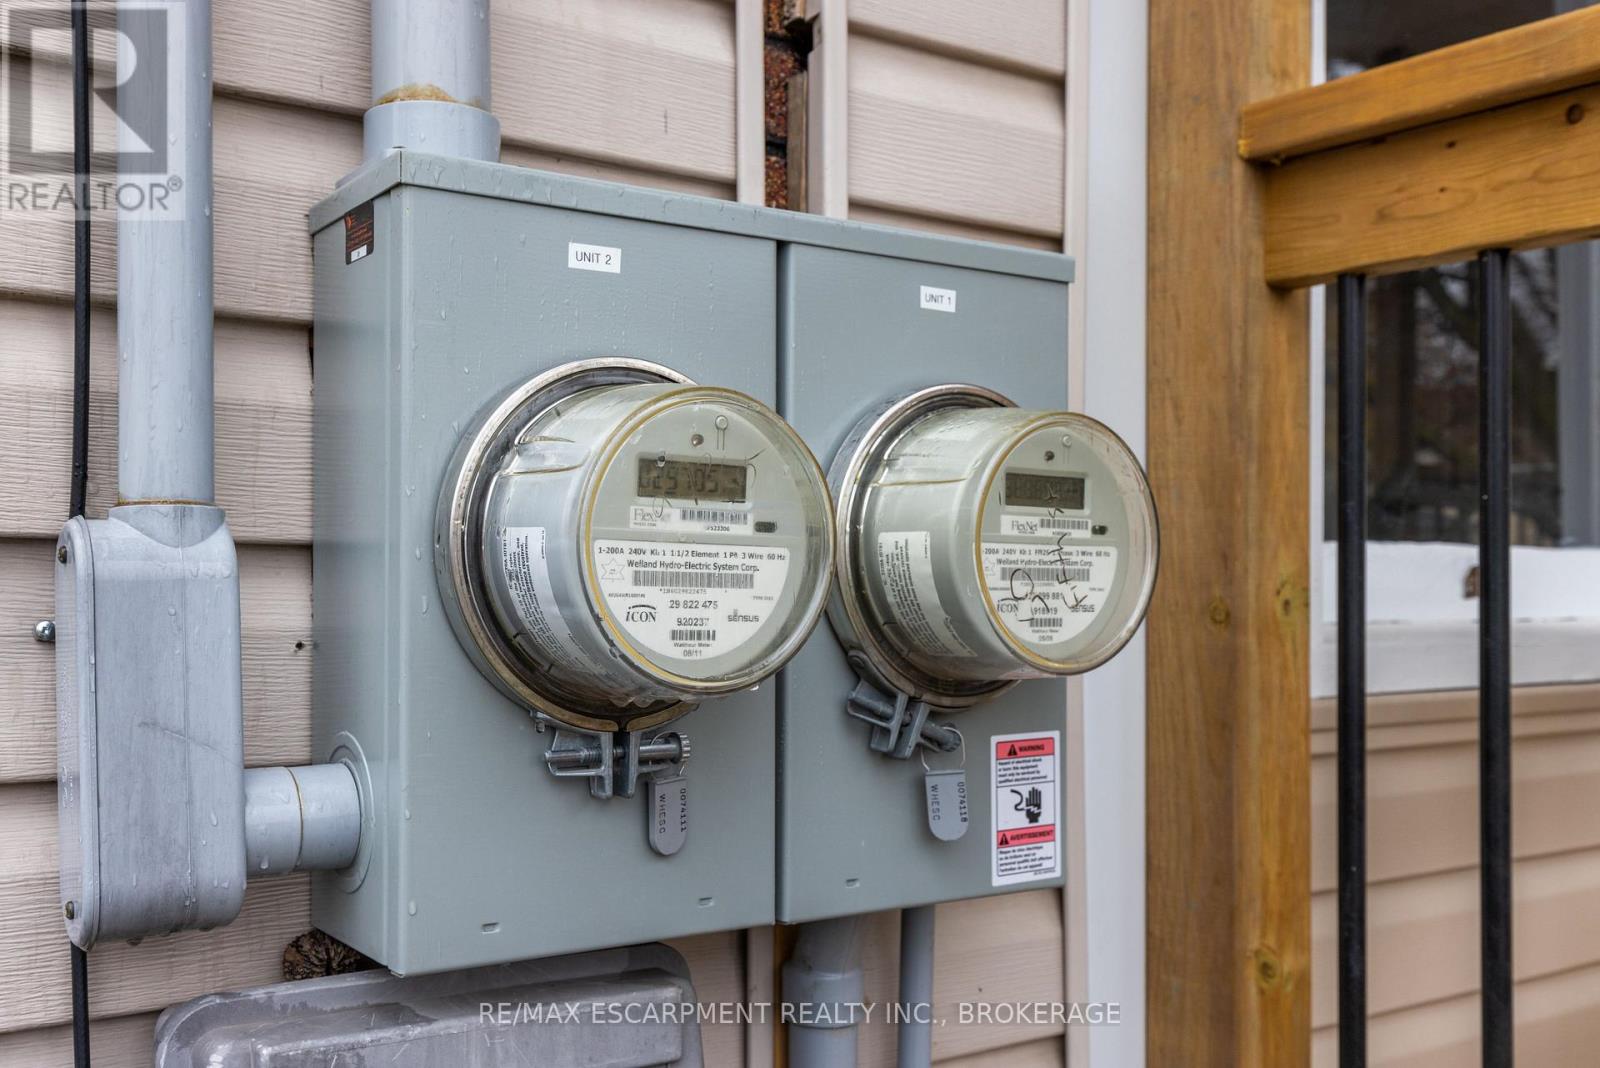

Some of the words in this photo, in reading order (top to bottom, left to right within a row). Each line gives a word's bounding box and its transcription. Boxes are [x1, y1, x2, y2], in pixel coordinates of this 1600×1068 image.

[575, 250, 601, 264] UNIT
[605, 253, 612, 265] 2
[924, 293, 945, 305] UNIT
[947, 296, 952, 306] 1
[598, 546, 624, 555] 1-200A
[691, 551, 719, 559] Element
[748, 553, 764, 561] Wire
[627, 559, 658, 569] Welland
[659, 560, 712, 571] Hydro-Electric
[713, 561, 740, 572] System
[741, 563, 760, 573] Corp.
[669, 600, 682, 609] 29
[682, 600, 700, 609] 822
[702, 600, 719, 610] 475
[930, 784, 941, 822] WHESC
